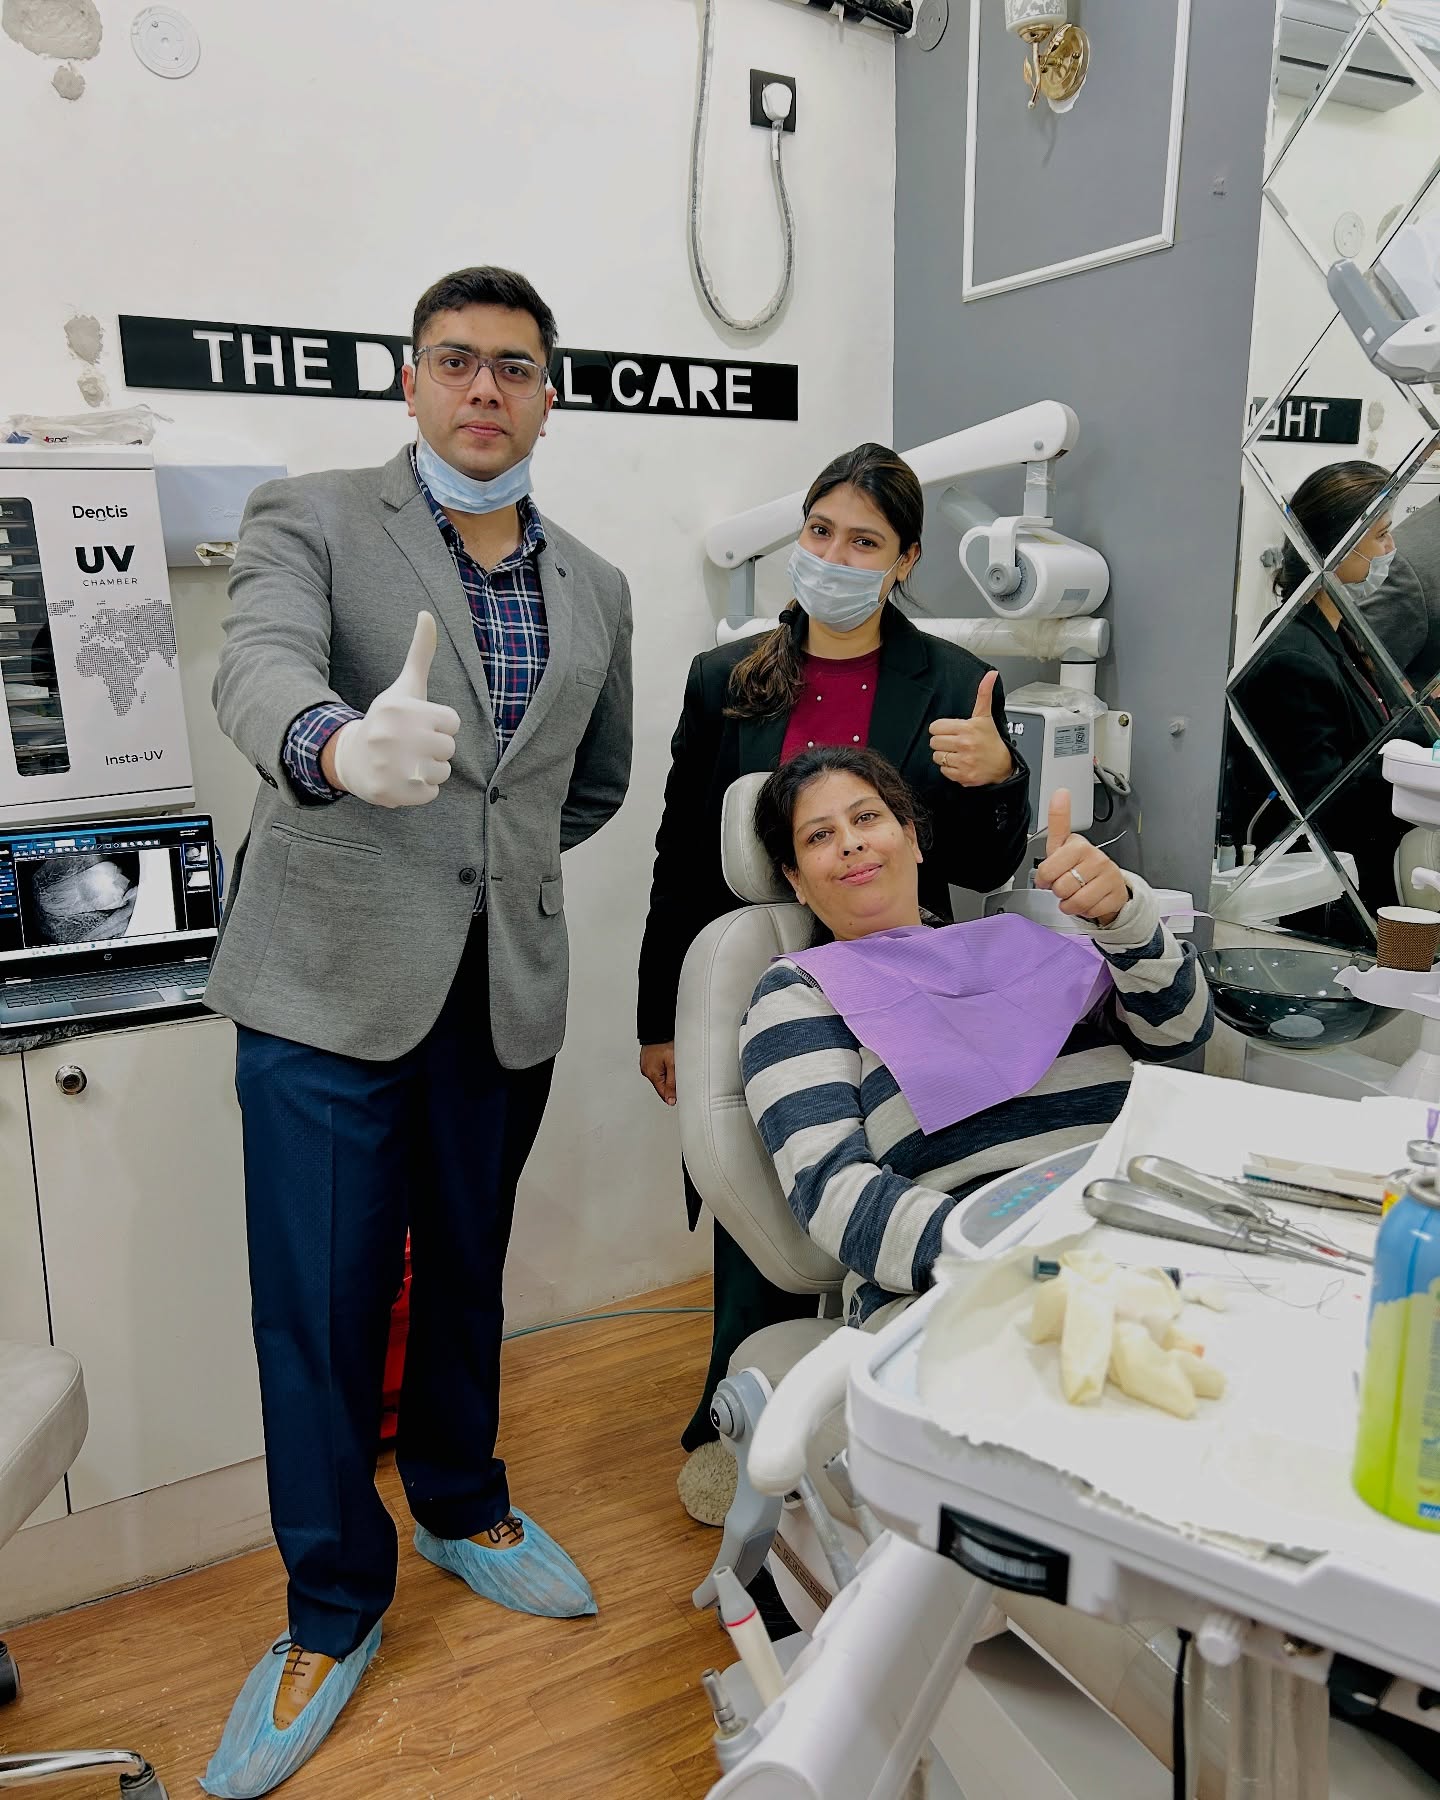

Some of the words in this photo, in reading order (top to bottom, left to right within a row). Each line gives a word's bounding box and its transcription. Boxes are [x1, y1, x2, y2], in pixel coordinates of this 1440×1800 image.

[193, 329, 333, 389] THE
[611, 359, 753, 412] CARE
[72, 505, 128, 519] Dentis
[75, 545, 135, 573] UV
[83, 577, 138, 586] CHAMBER
[105, 749, 164, 766] Insta-UV
